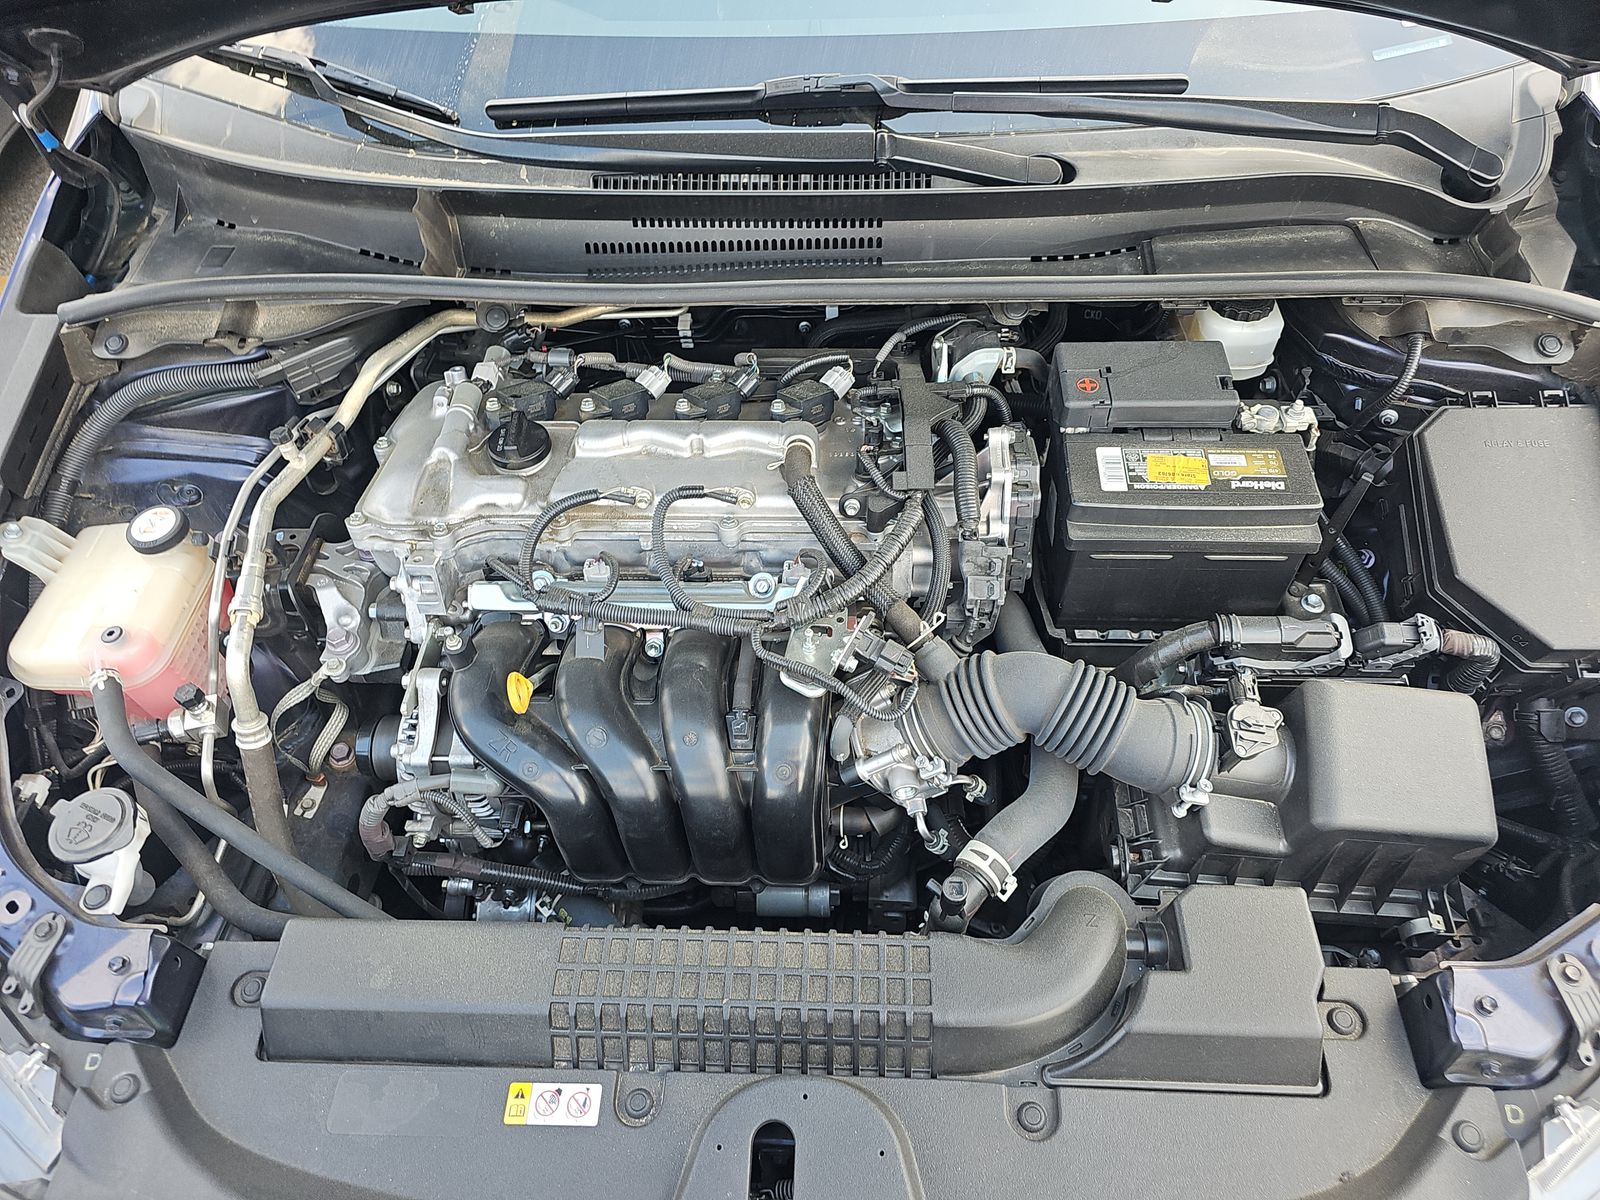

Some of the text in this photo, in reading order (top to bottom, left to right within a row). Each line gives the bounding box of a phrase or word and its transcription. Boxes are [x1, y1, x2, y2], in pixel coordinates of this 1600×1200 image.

[1525, 439, 1550, 448] FUSE
[1230, 480, 1286, 490] DieHard
[487, 728, 519, 763] ZR
[84, 1052, 102, 1071] D
